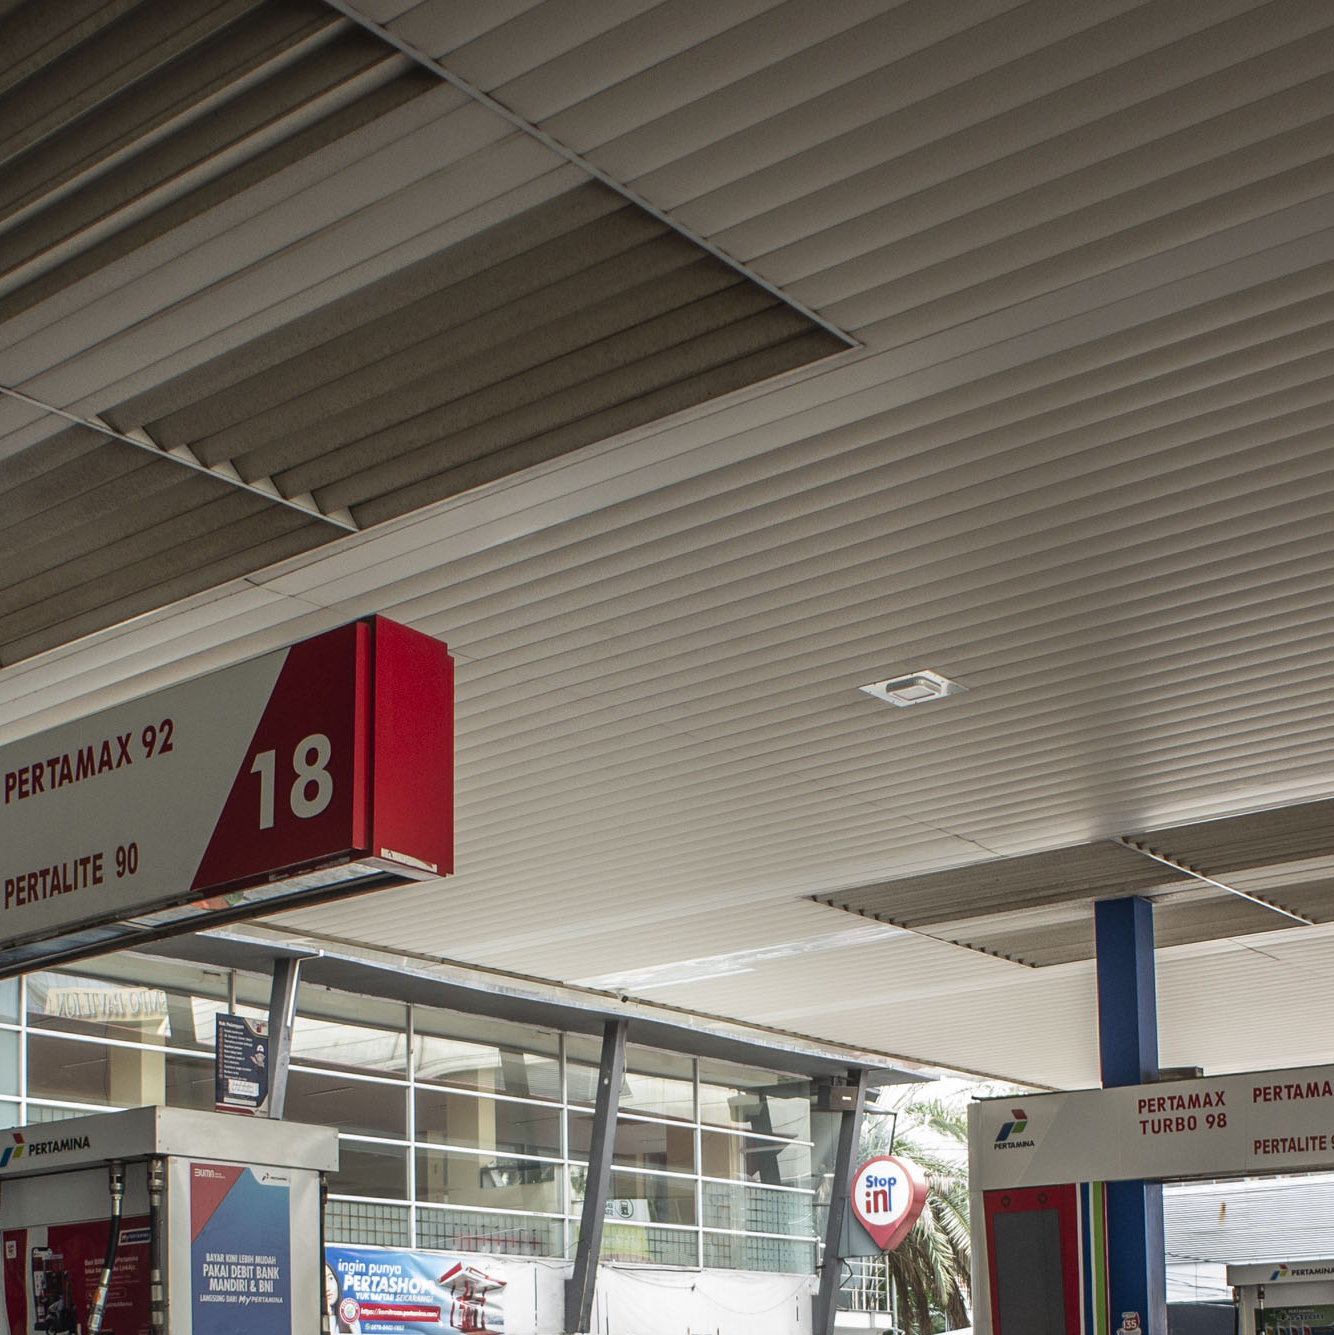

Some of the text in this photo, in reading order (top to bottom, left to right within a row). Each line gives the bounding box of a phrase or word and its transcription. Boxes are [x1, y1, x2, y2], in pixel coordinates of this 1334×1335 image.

[5, 718, 174, 804] PERTAMAX 92
[250, 733, 334, 830] 18
[4, 842, 139, 910] PERTALITE 90
[1138, 1091, 1226, 1114] PERTAMAX
[1139, 1112, 1228, 1136] TURBO 98
[28, 1136, 91, 1157] PERTAMINA
[994, 1140, 1035, 1151] PERTAMINA
[1254, 1135, 1327, 1155] PERTALITE
[865, 1189, 888, 1213] in
[206, 1253, 224, 1262] BAYAR
[239, 1254, 254, 1263] LEBIH
[255, 1255, 276, 1265] MUDAH
[338, 1259, 402, 1277] ingin punya
[203, 1264, 280, 1280] PAKAI DEBIT BANK
[209, 1278, 274, 1293] MANDIRI & BNI
[355, 1292, 370, 1301] YUK
[370, 1293, 395, 1302] DAFTAR
[1123, 1319, 1137, 1330] 135
